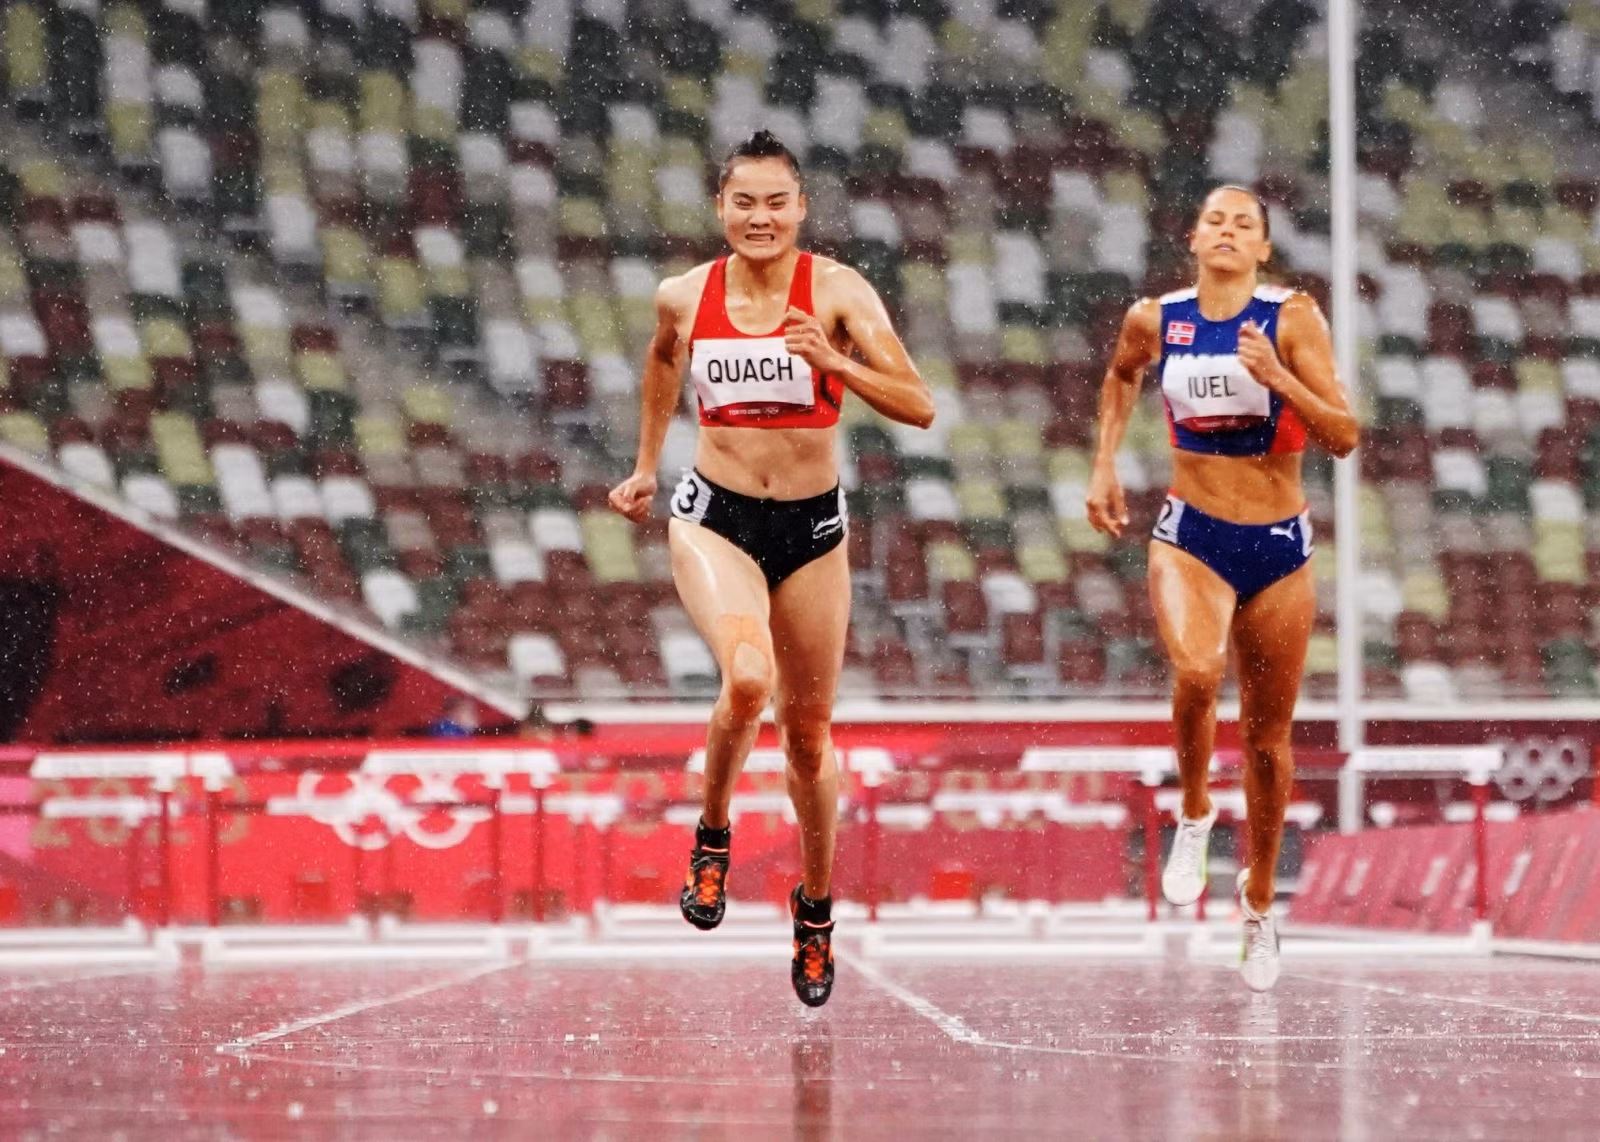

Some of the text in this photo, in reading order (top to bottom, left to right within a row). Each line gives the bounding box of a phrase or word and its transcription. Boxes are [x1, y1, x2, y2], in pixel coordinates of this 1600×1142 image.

[707, 357, 793, 384] QUACH
[1188, 375, 1238, 399] IUEL
[677, 478, 699, 514] 3
[1157, 499, 1173, 537] 2
